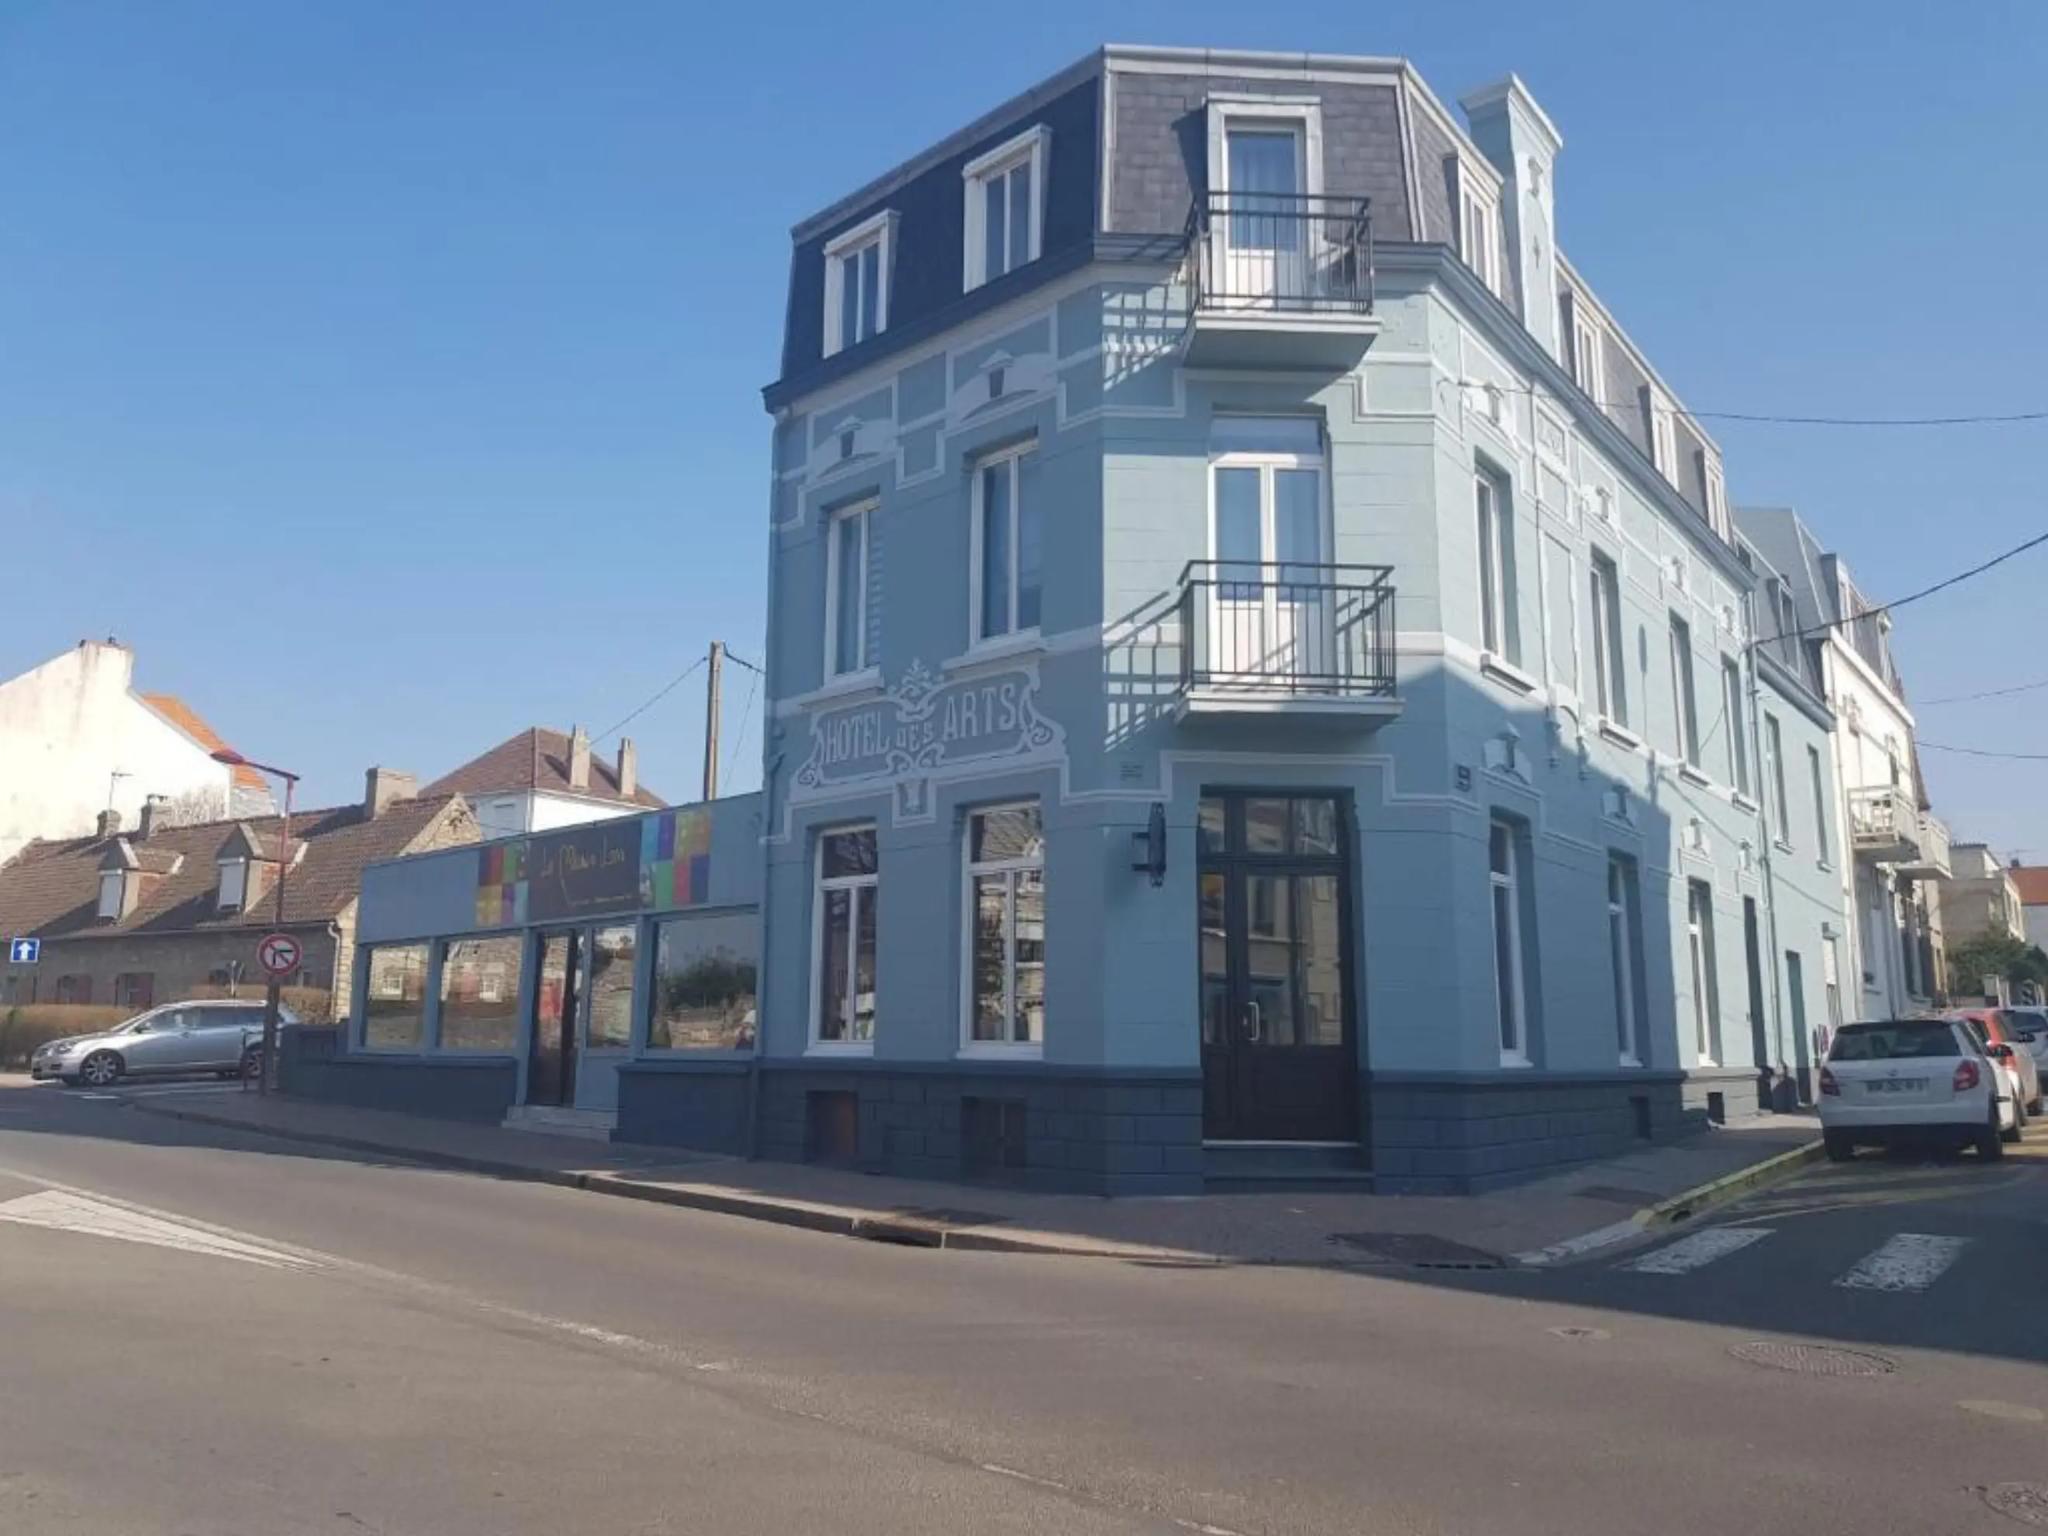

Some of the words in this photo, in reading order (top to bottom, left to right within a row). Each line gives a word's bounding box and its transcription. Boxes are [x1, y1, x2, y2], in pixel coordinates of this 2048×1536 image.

[825, 711, 890, 764] HOTEL
[895, 721, 934, 752] DES
[943, 683, 1016, 742] ARTS
